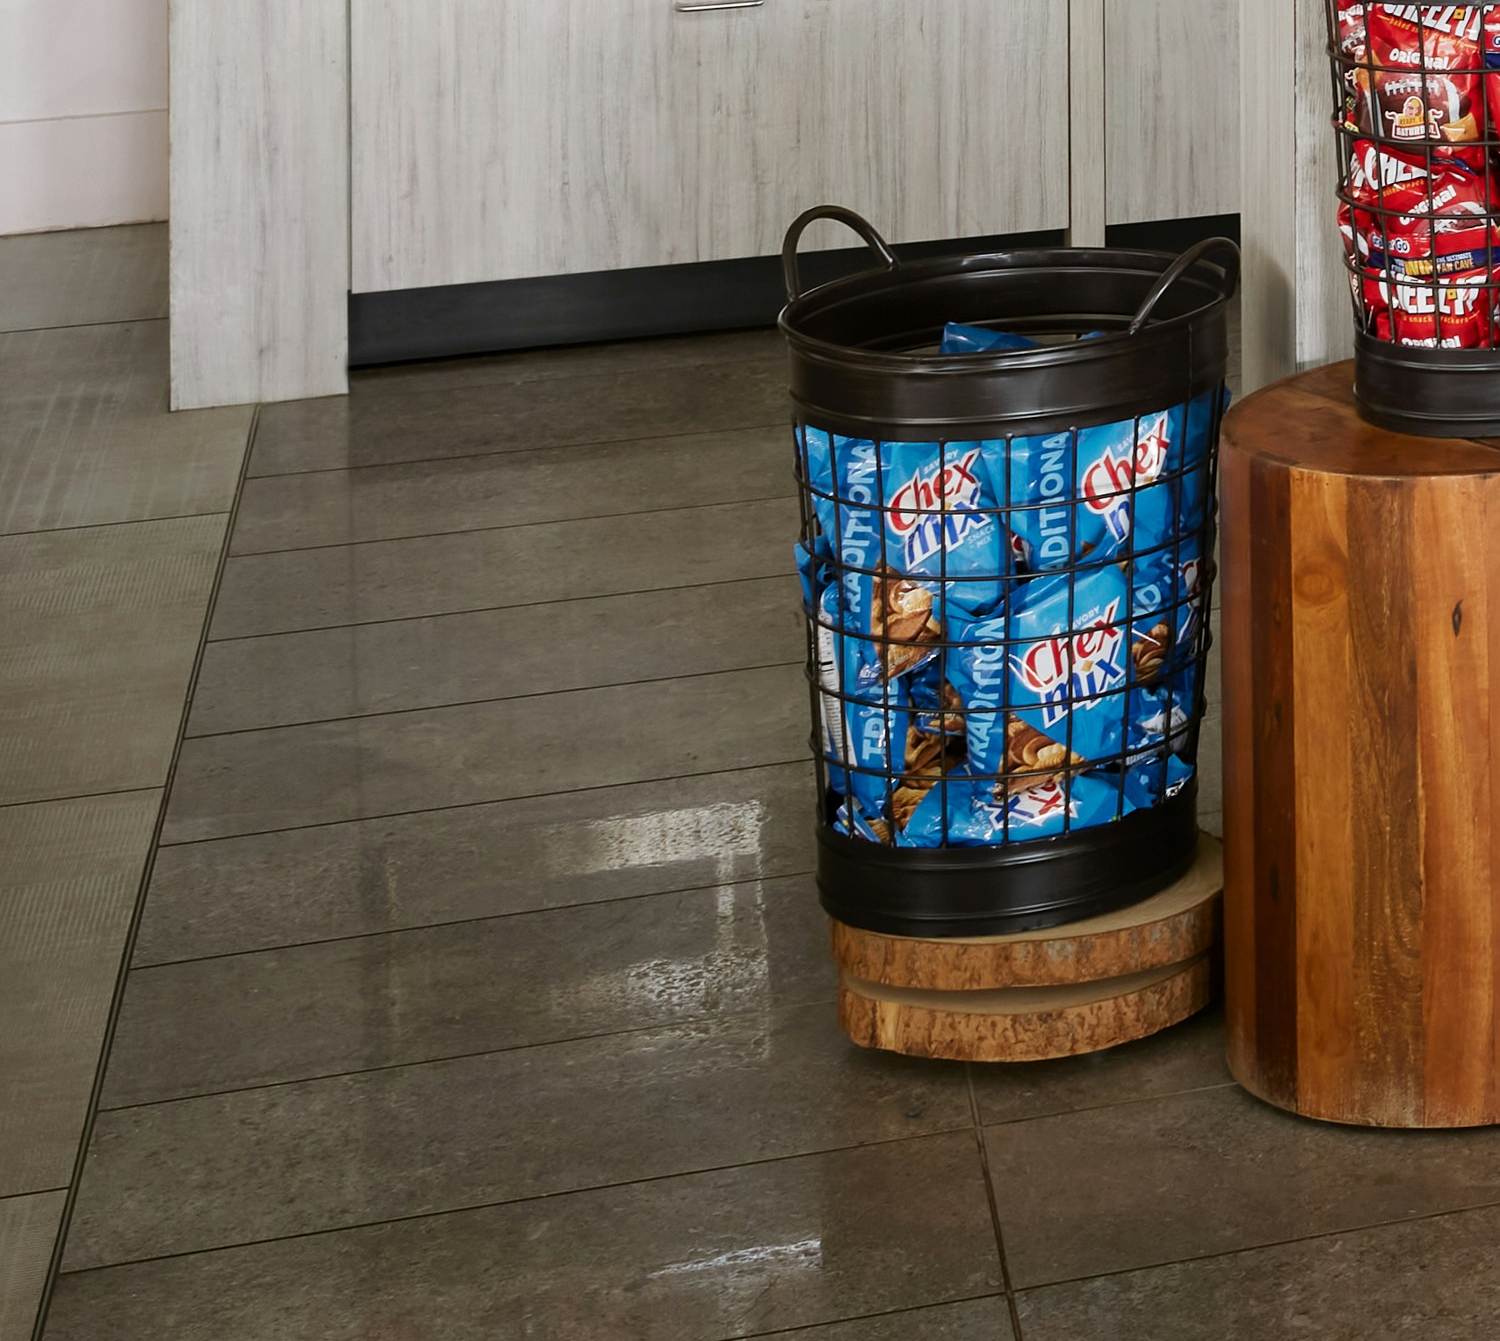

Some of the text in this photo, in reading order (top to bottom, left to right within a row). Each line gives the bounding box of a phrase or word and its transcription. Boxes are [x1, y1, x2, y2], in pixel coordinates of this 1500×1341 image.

[890, 453, 976, 531] Chex
[968, 524, 996, 544] SNACK
[1026, 603, 1119, 687] Chex
